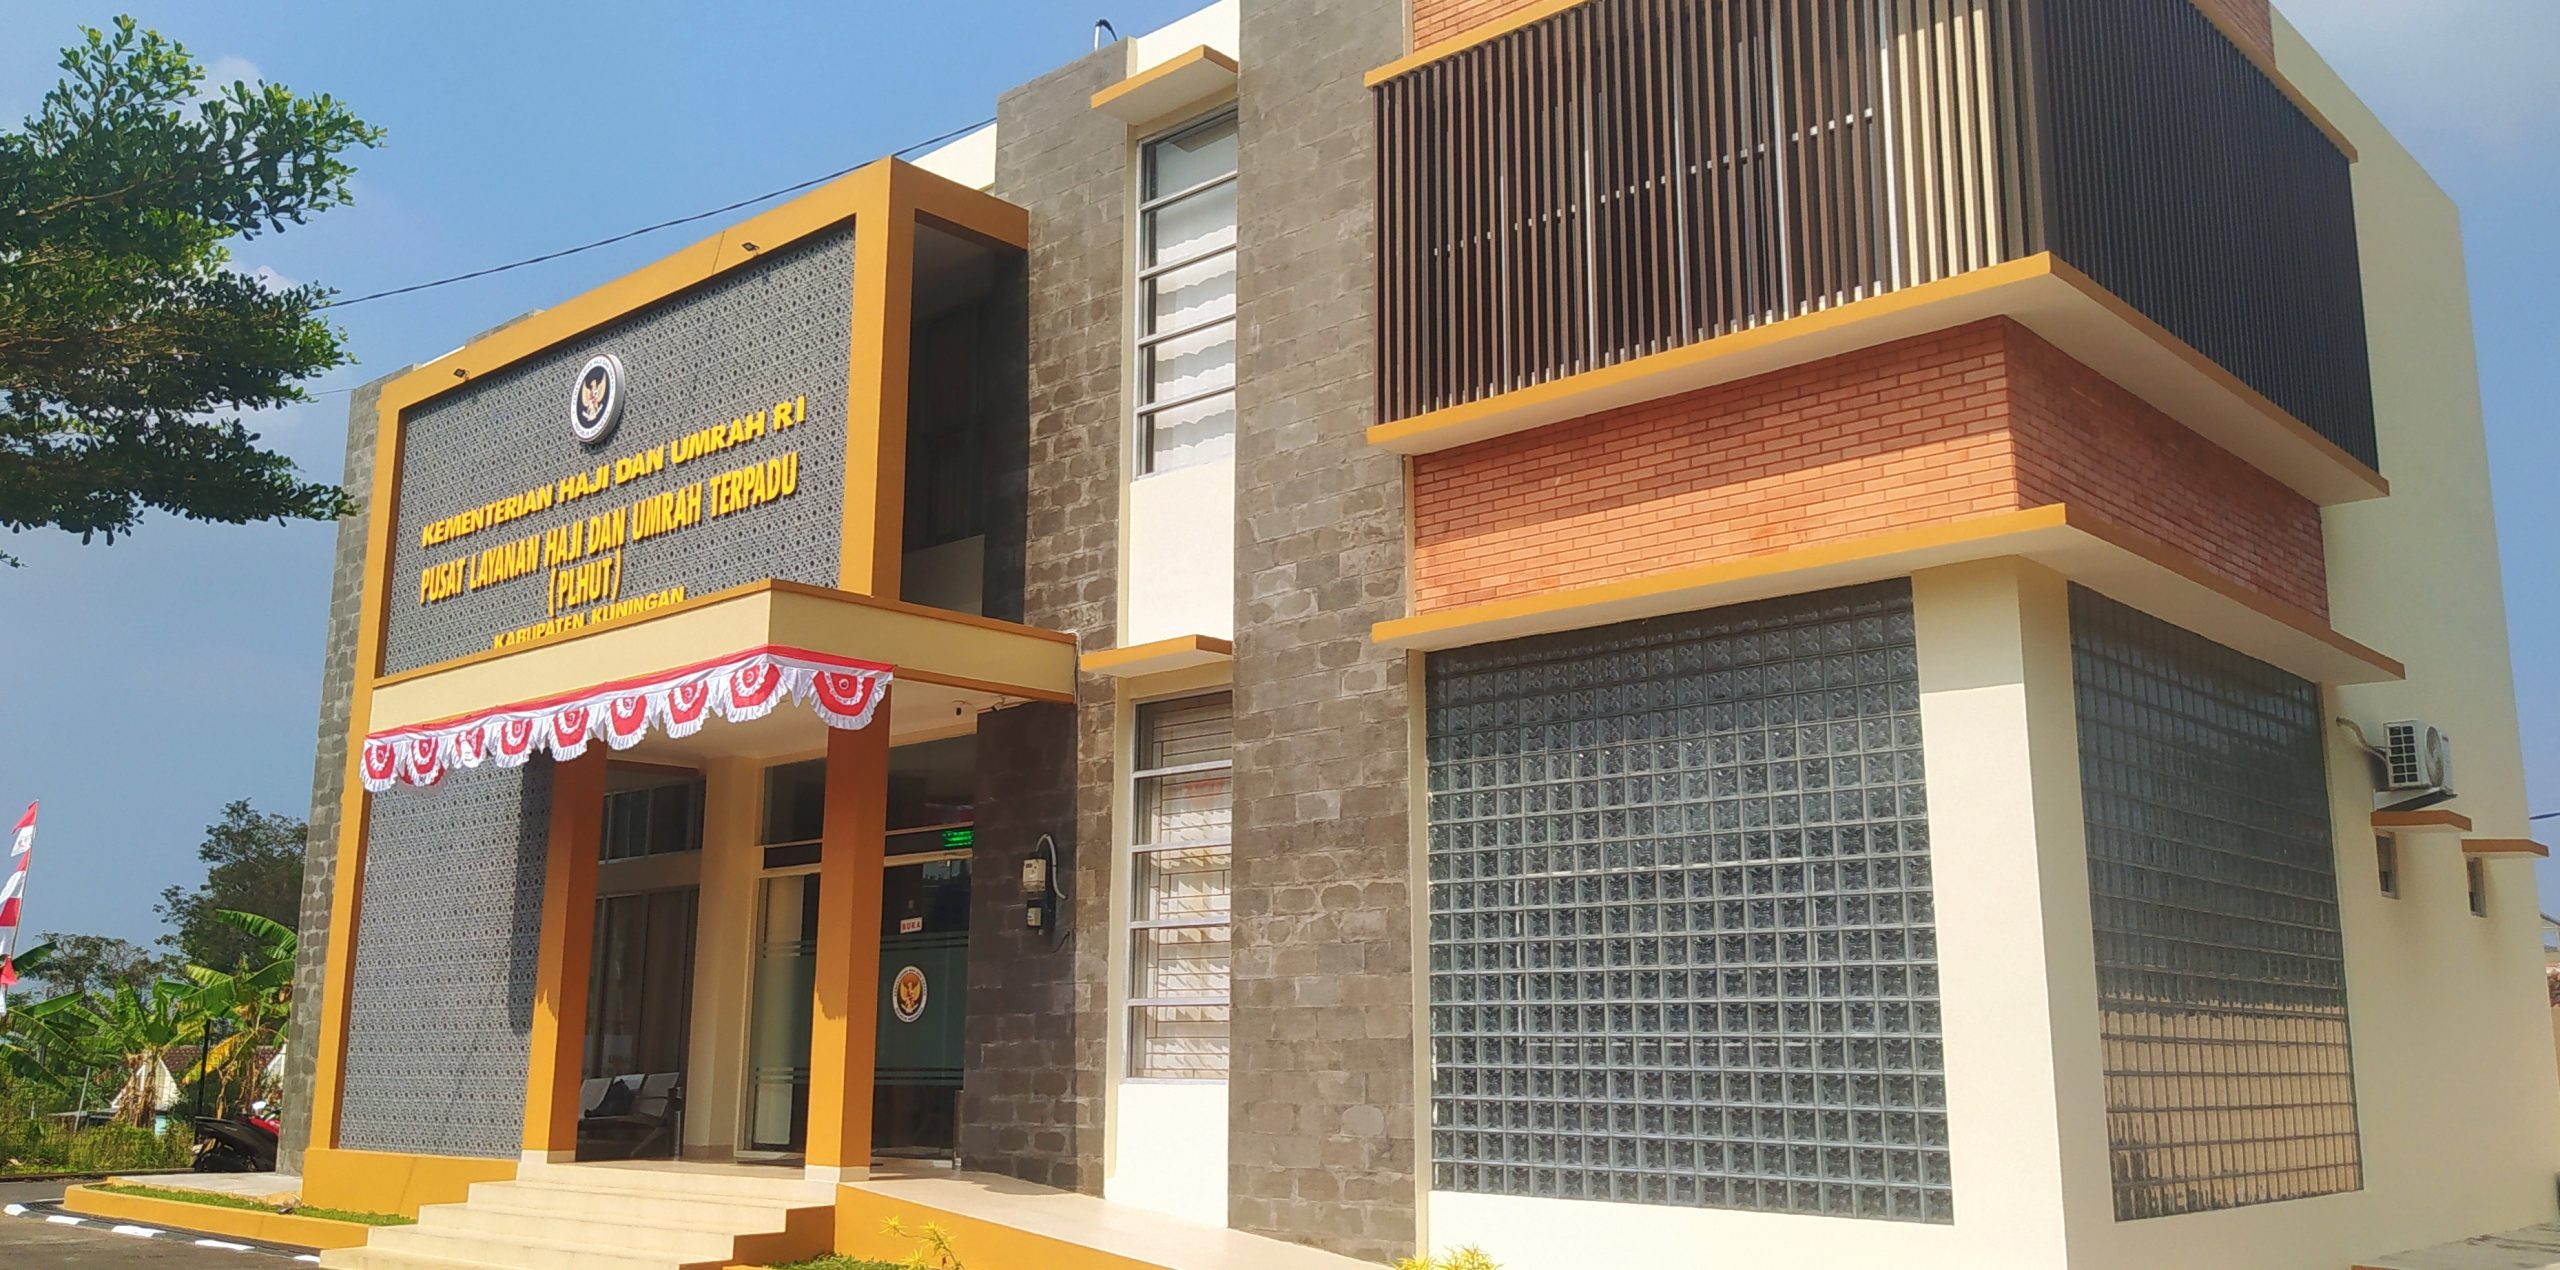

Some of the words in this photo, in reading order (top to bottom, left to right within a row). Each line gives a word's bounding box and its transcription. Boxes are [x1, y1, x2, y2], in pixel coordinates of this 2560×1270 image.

[422, 485, 553, 547] KEMENTERIAN
[558, 463, 609, 503] HAJI
[615, 445, 664, 485] DAN
[671, 411, 765, 464] UMRAH
[773, 395, 805, 430] RI
[420, 557, 466, 605] PUSAT
[469, 534, 540, 590] LAYANAN
[544, 520, 583, 567] HAJI
[588, 507, 626, 554] DAN
[632, 482, 702, 541] UMRAH
[709, 452, 797, 518] TERPADU
[548, 549, 621, 617] (PLHUT)
[902, 920, 920, 931] BUKA
